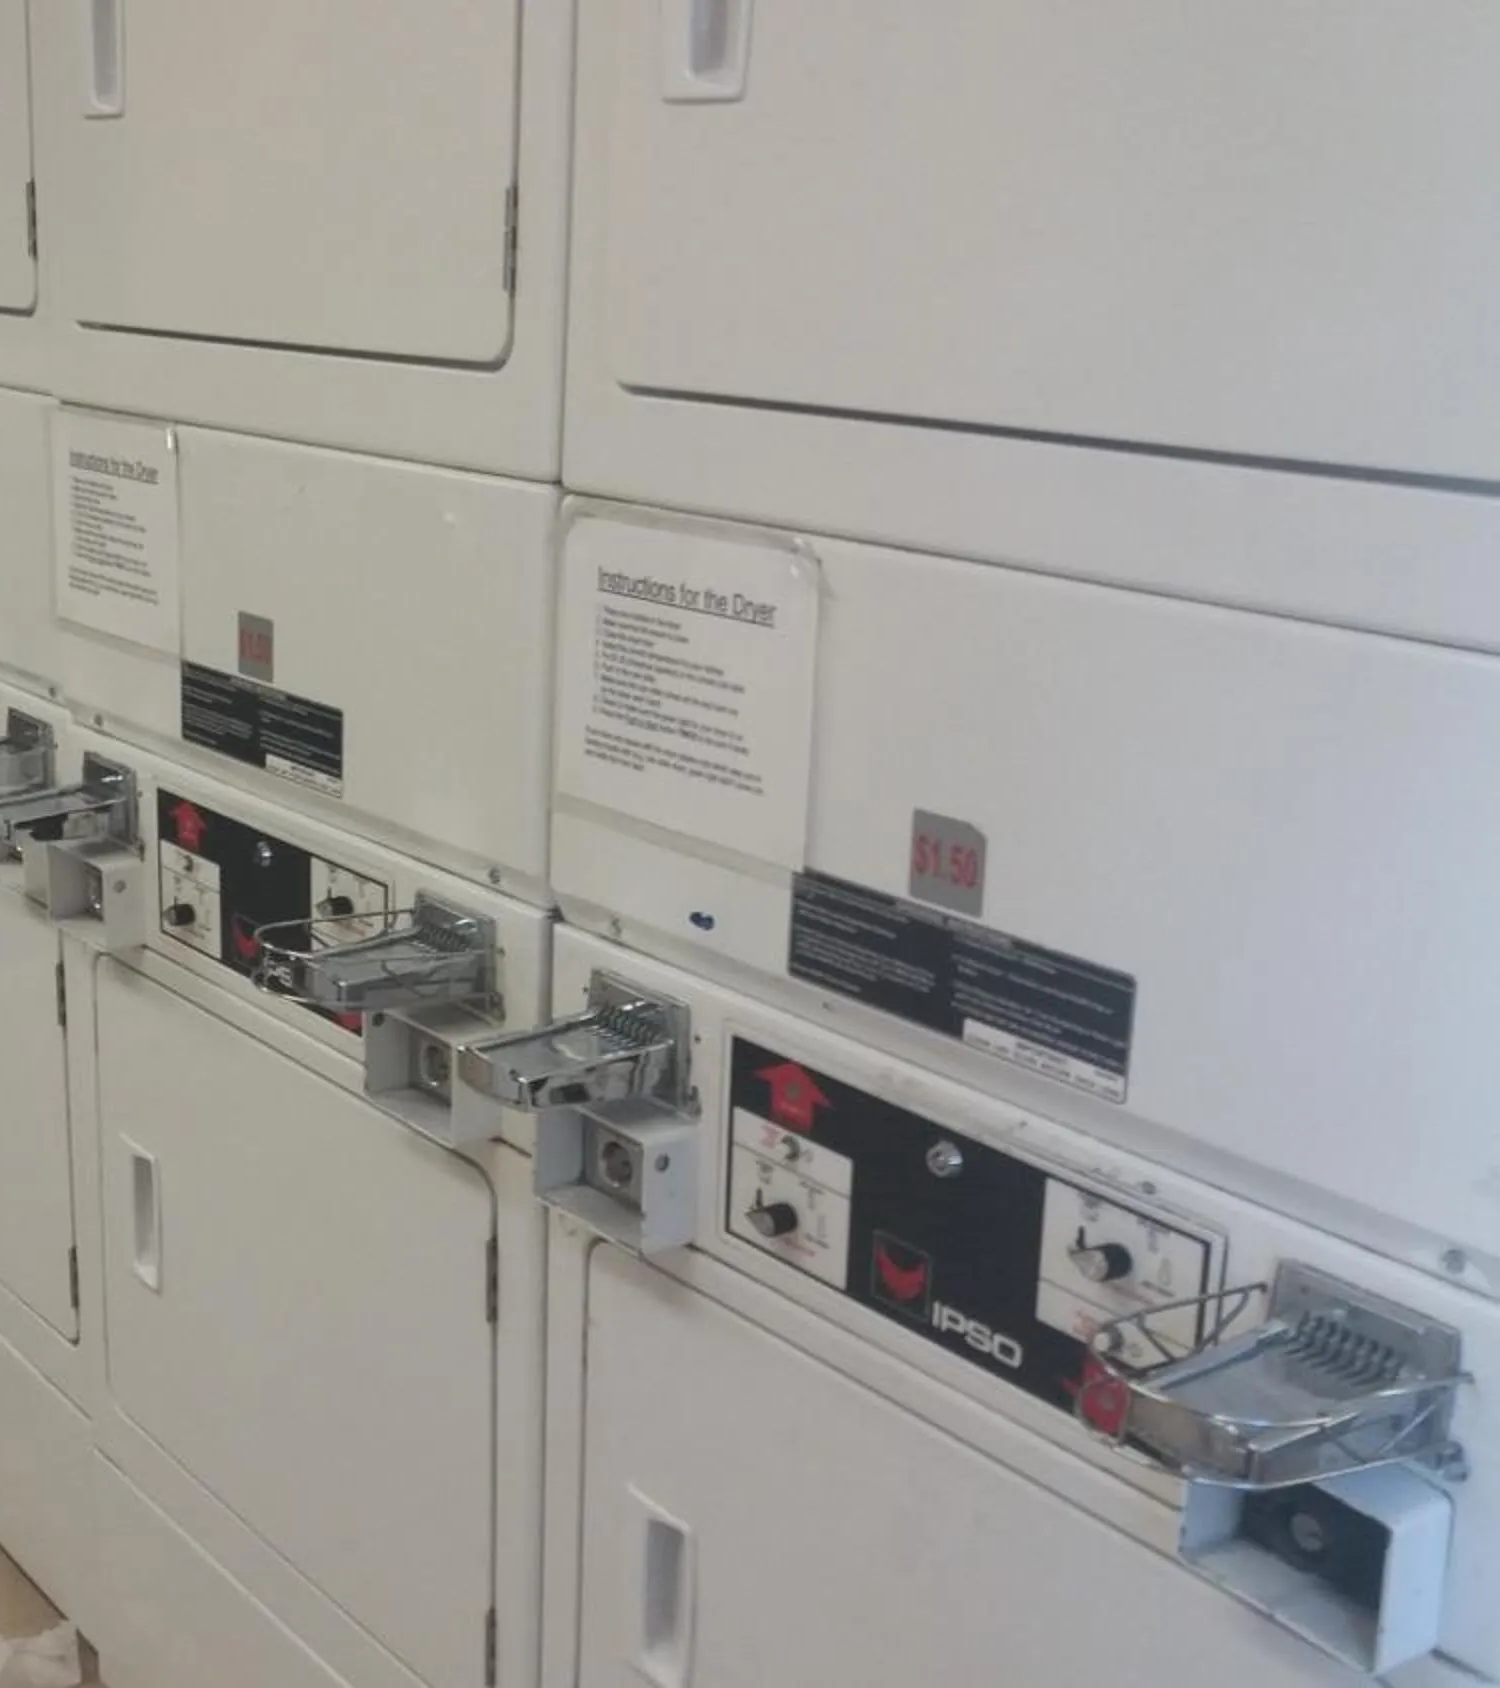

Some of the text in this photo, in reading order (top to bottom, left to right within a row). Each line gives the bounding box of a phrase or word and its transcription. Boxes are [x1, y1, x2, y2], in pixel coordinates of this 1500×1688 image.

[598, 565, 777, 625] Instructions for the Dryer
[913, 833, 980, 890] $1.50
[931, 1301, 1023, 1369] IPSO
